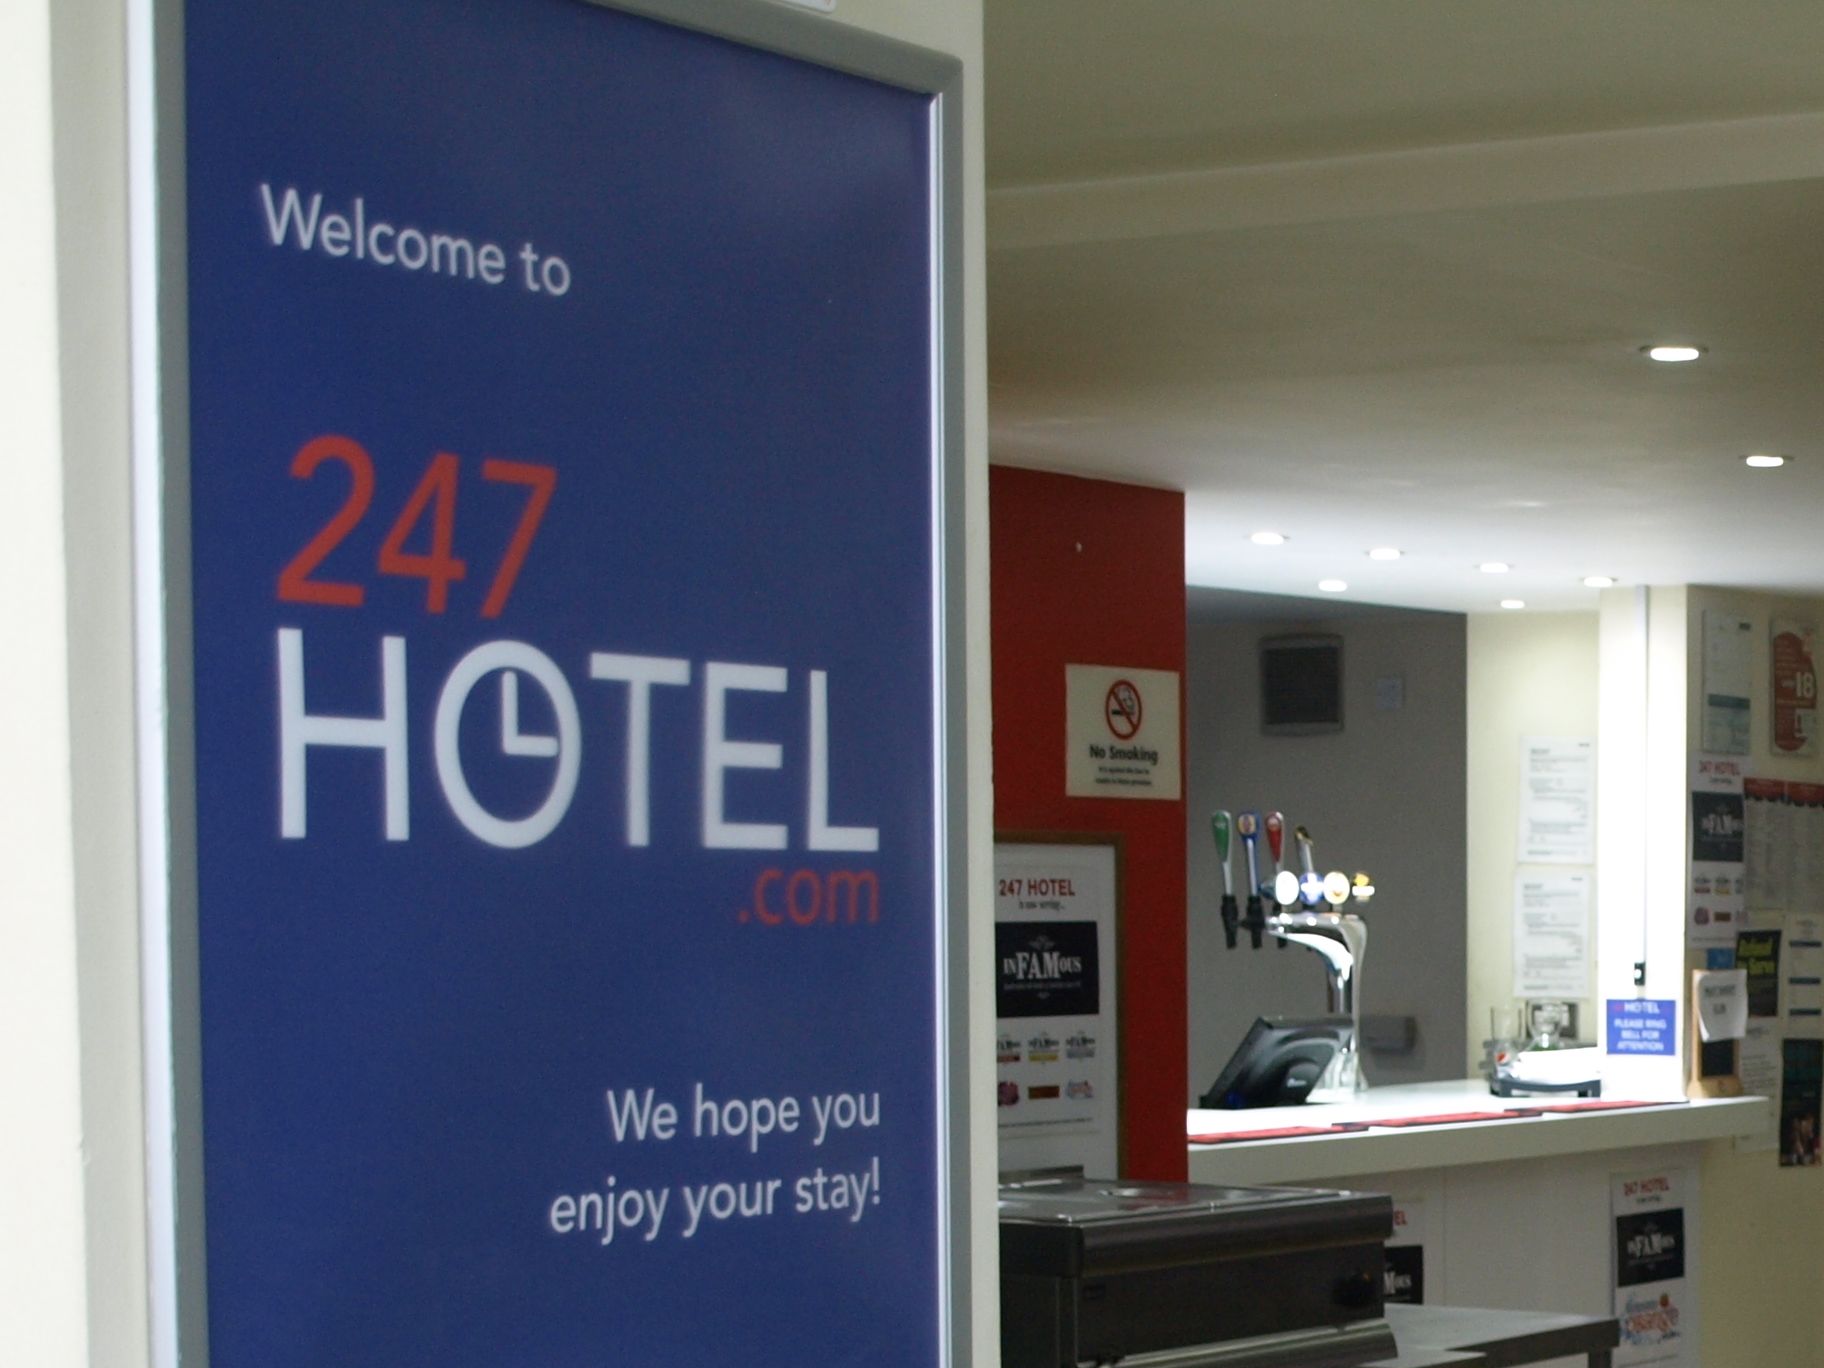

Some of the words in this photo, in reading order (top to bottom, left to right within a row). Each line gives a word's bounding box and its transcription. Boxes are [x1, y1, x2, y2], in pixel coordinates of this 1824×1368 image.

[260, 183, 505, 286] Welcome
[520, 248, 571, 297] to
[276, 434, 557, 619] 247
[278, 627, 880, 852] HOTEL
[1089, 743, 1106, 758] No
[1109, 744, 1158, 766] Smoking
[738, 868, 881, 926] .com
[999, 879, 1023, 897] 247
[1028, 879, 1076, 897] HOTEL
[607, 1088, 678, 1142] We
[694, 1082, 800, 1153] hope
[812, 1092, 880, 1146] you
[550, 1176, 669, 1245] enjoy
[683, 1178, 782, 1238] your
[795, 1156, 881, 1222] stay!
